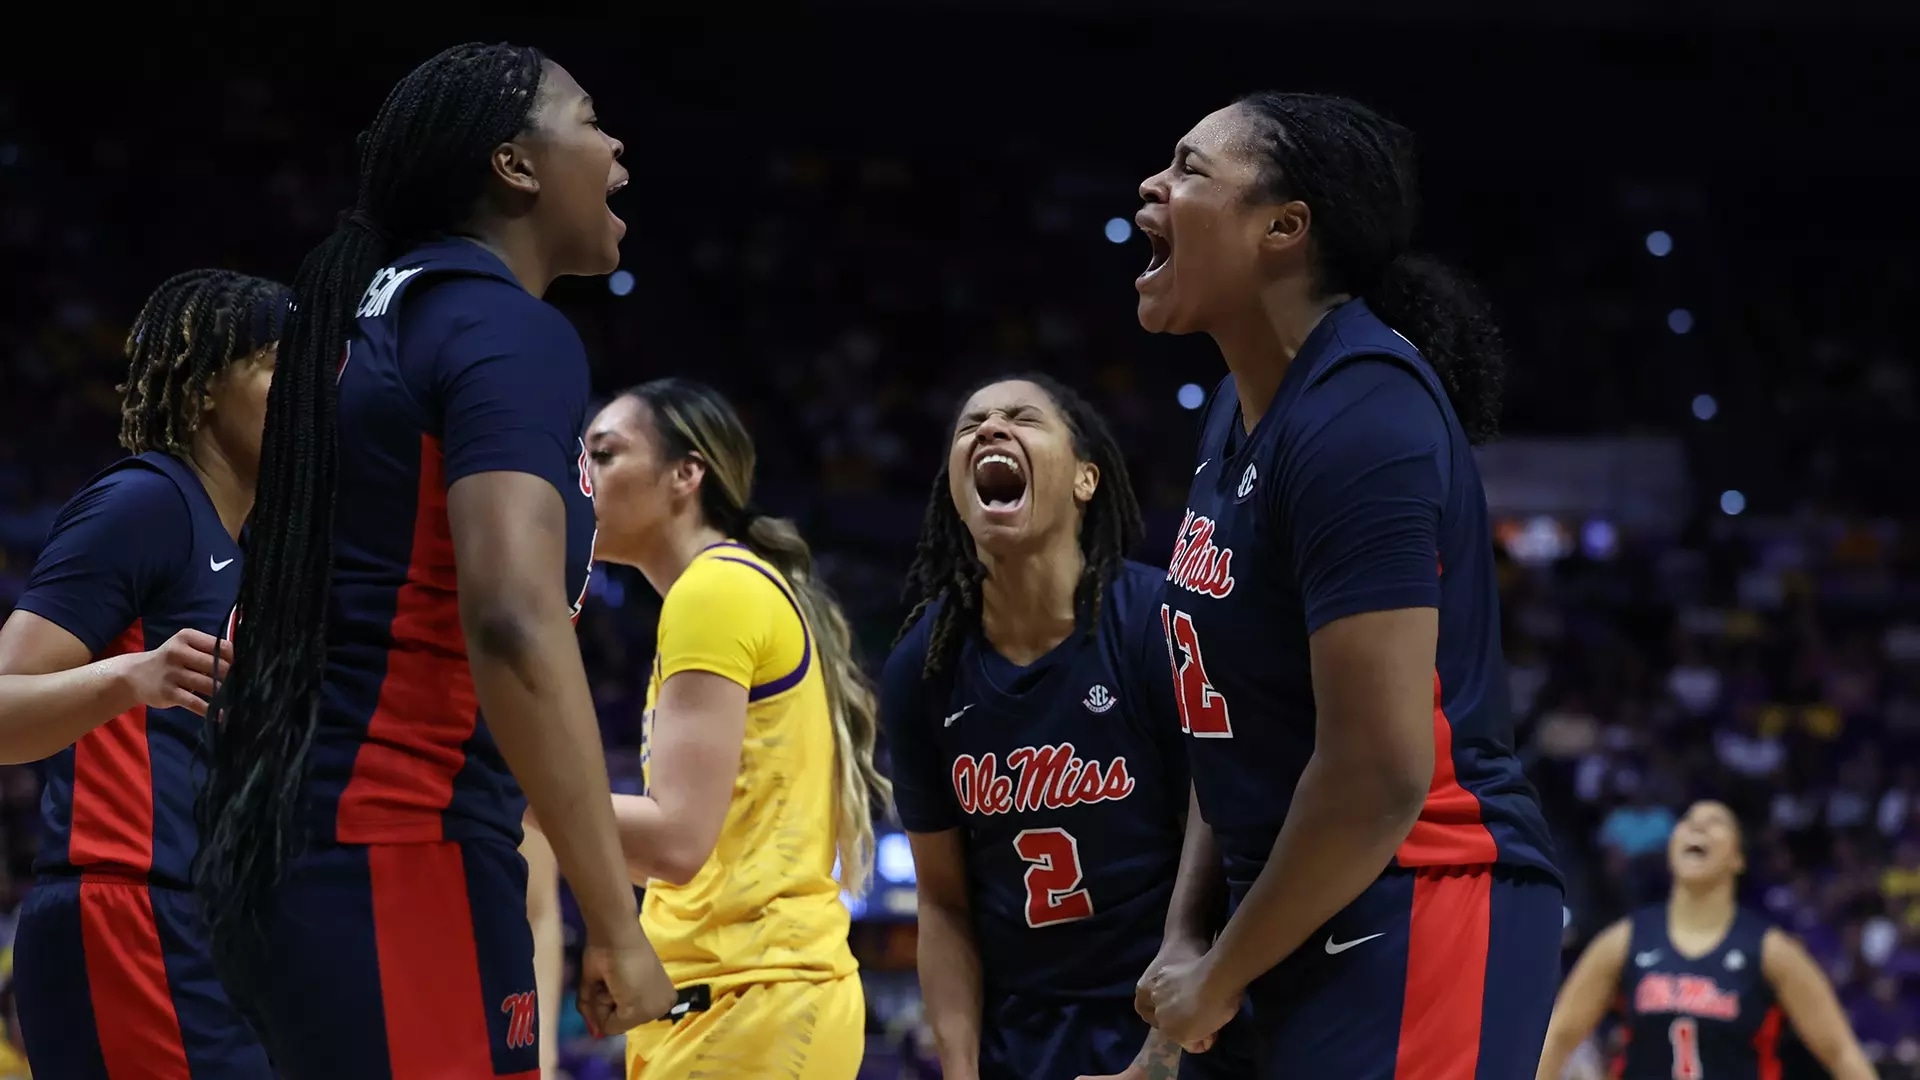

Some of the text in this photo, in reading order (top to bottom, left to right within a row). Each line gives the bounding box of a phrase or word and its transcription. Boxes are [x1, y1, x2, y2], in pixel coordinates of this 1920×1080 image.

[1174, 516, 1235, 599] Miss
[1088, 684, 1109, 706] SEC
[953, 742, 1135, 815] Ole Miss
[1012, 827, 1094, 928] 2
[501, 990, 535, 1050] M
[1669, 1017, 1703, 1080] 1
